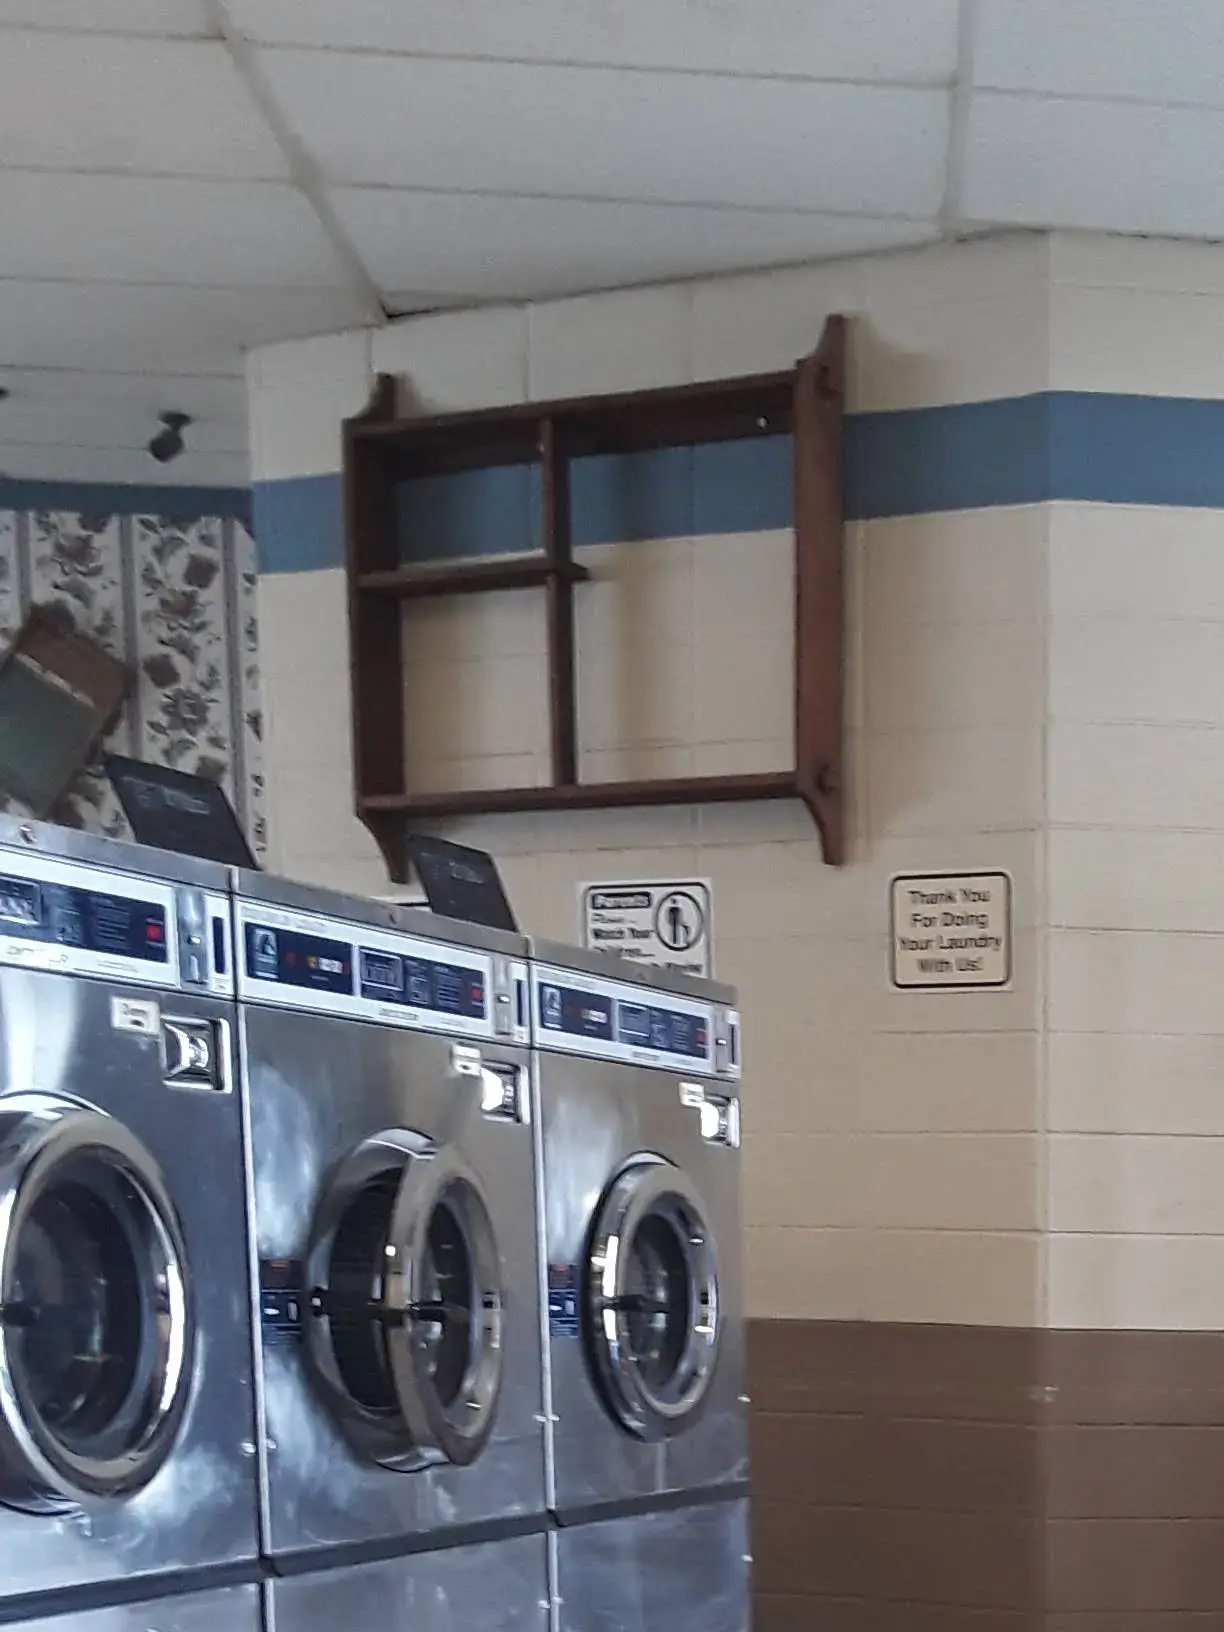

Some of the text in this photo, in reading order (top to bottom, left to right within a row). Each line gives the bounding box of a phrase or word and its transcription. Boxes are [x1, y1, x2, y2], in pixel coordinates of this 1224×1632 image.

[907, 888, 990, 904] Thank You
[911, 911, 989, 929] For Doing
[900, 935, 1001, 951] Your Laundry
[918, 958, 953, 972] With
